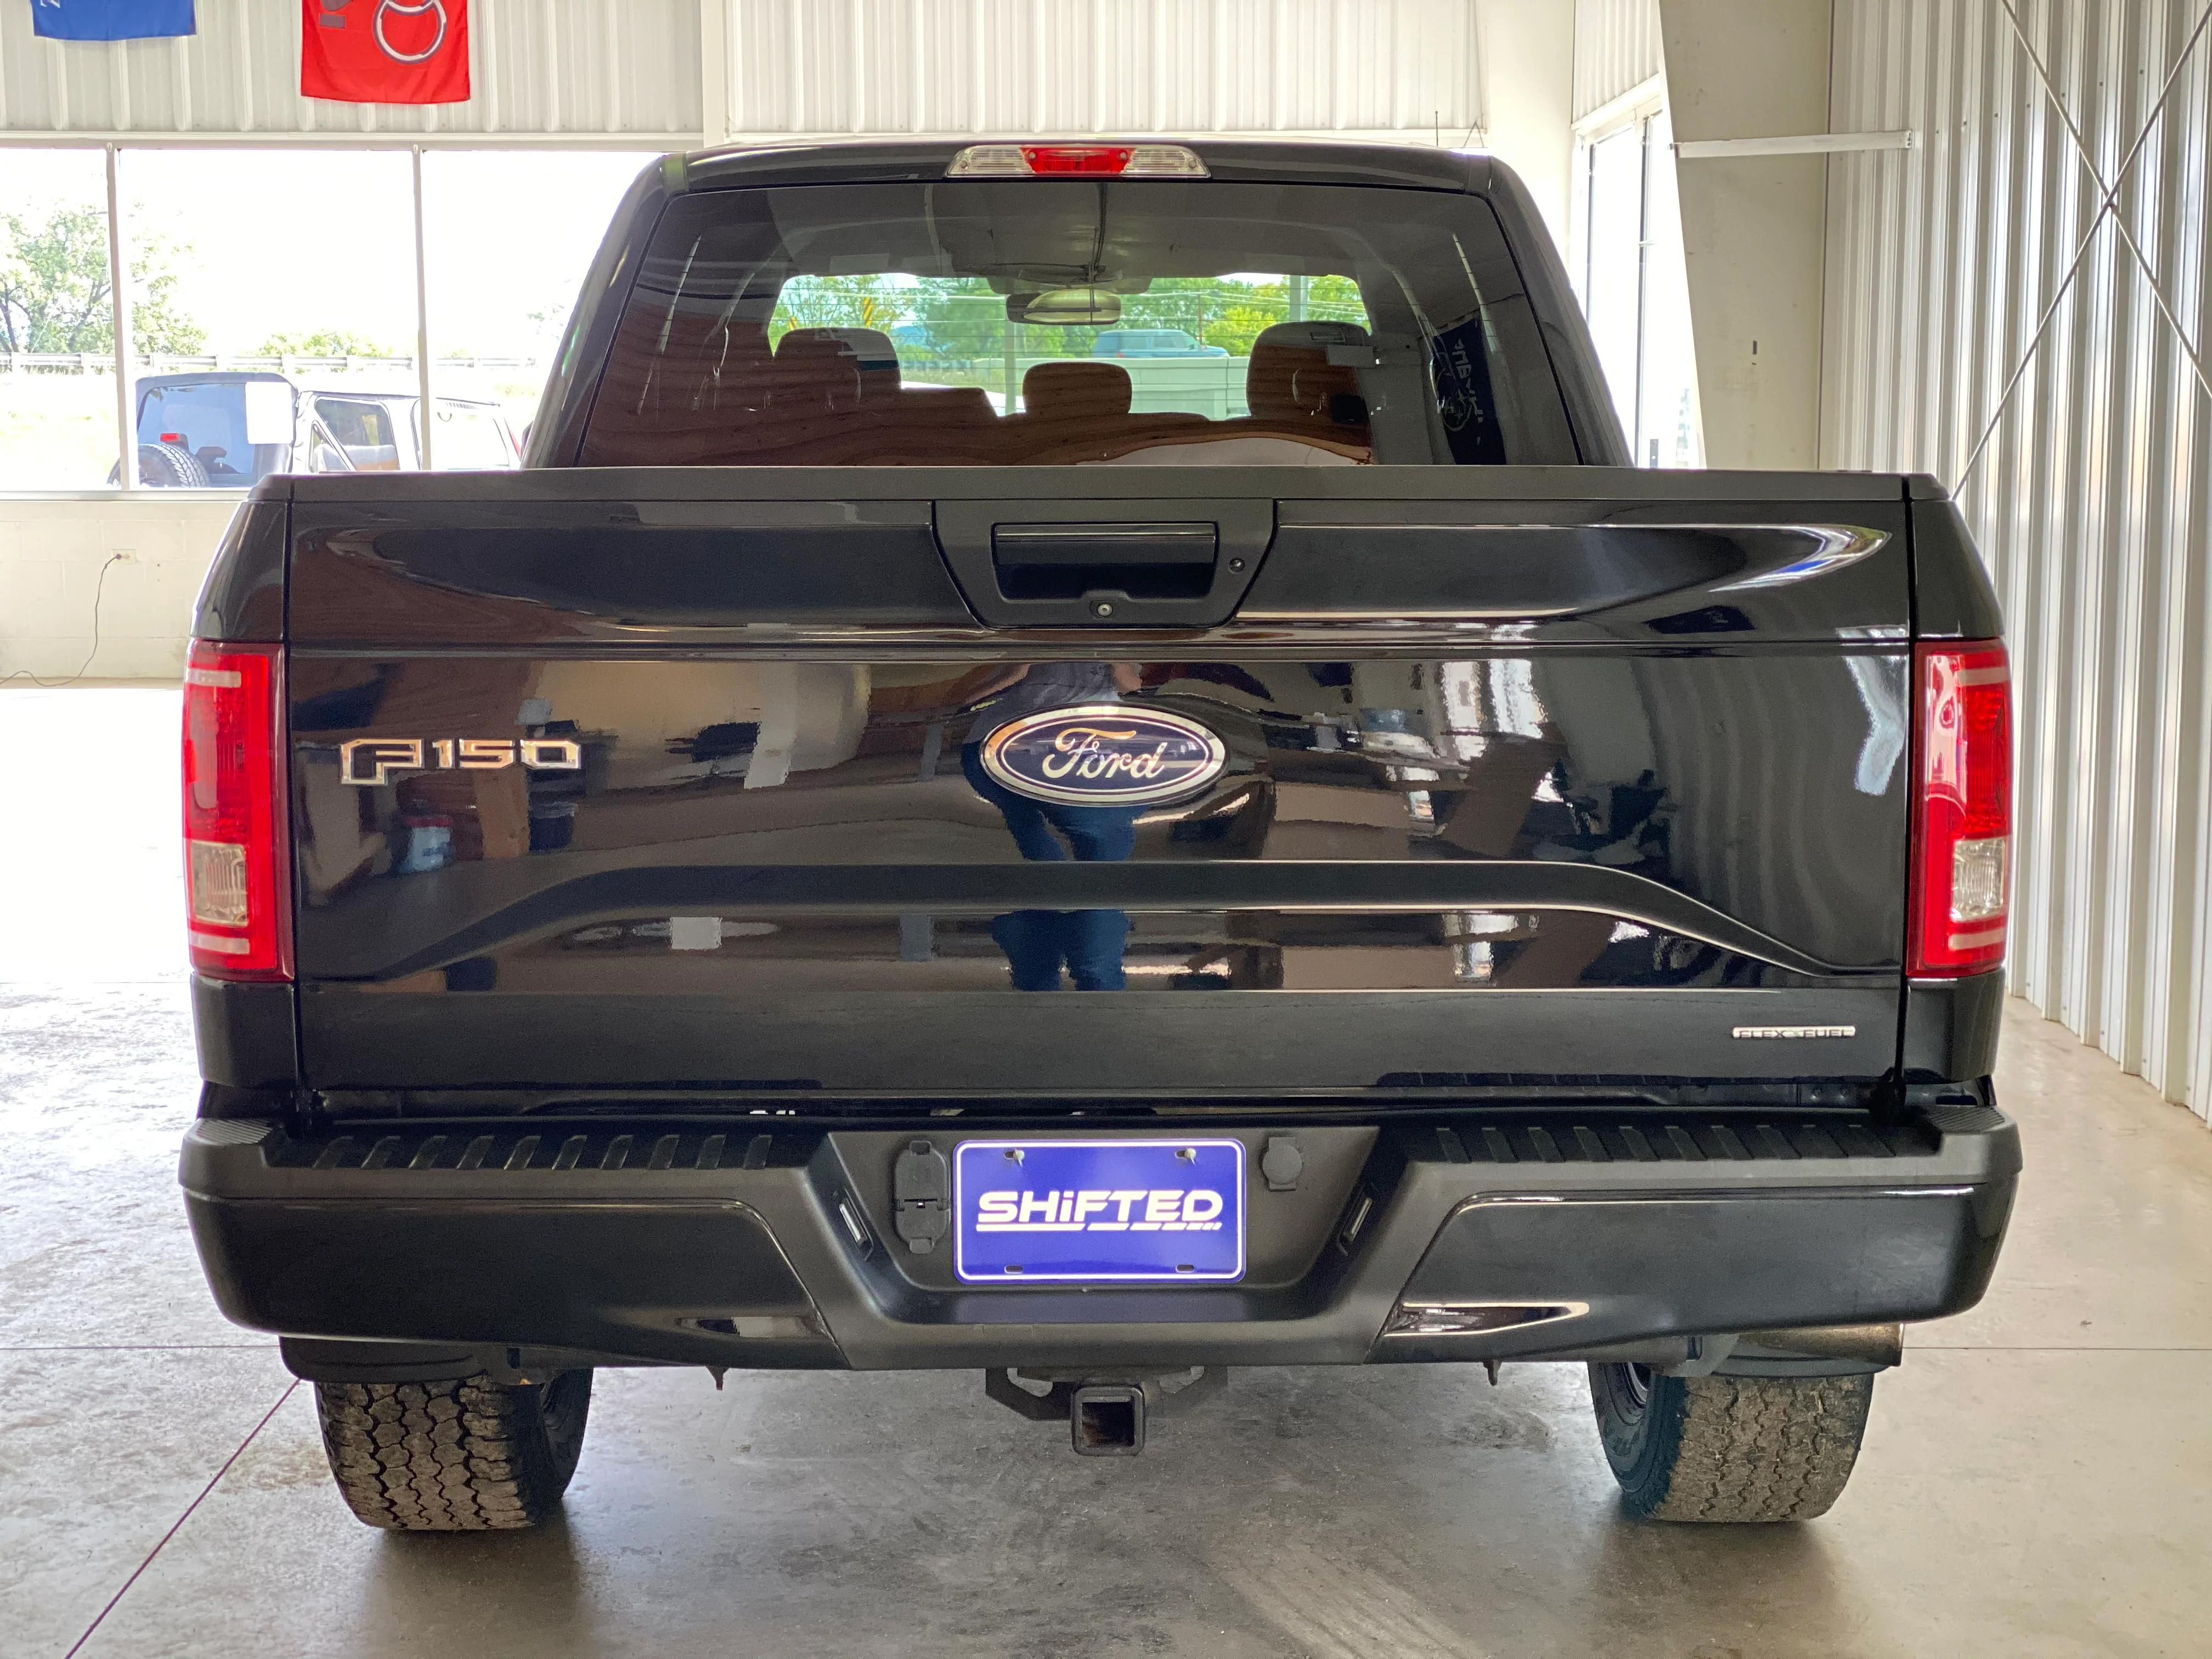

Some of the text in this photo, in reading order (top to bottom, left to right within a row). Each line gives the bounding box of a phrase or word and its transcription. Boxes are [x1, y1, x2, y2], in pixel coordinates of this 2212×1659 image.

[1042, 727, 1168, 779] Ford
[1739, 1028, 1852, 1039] FLEX FUEL
